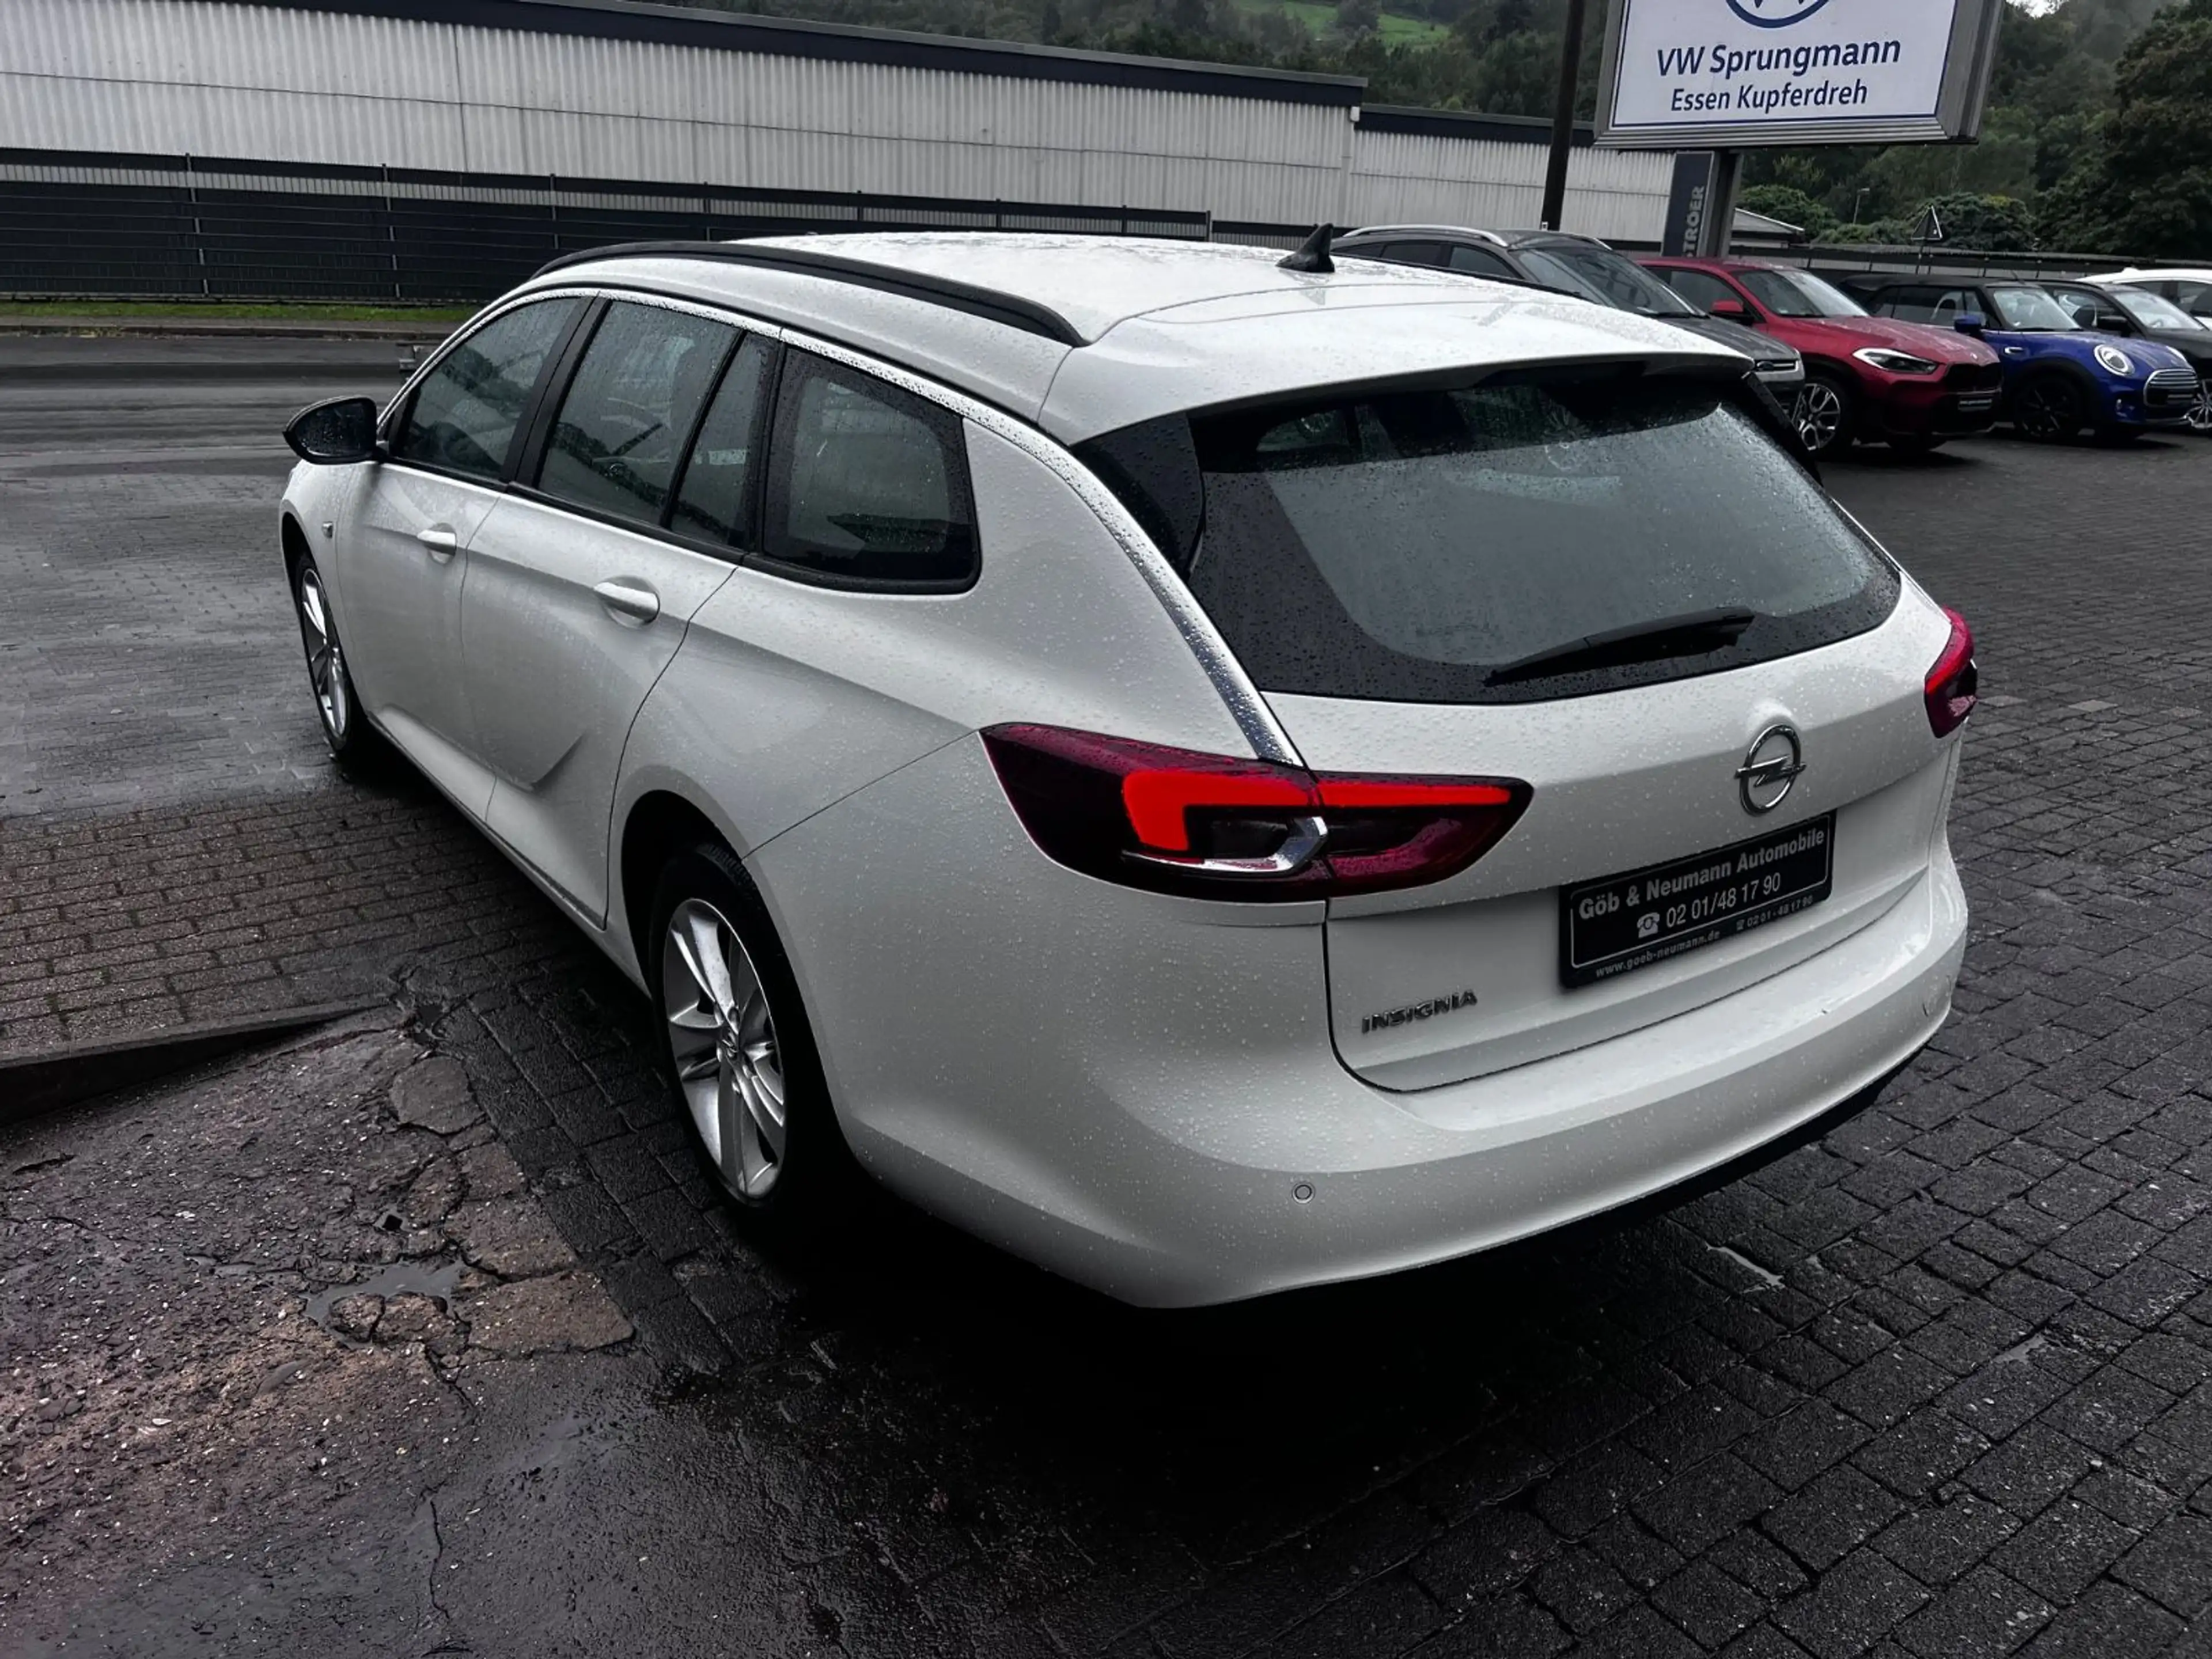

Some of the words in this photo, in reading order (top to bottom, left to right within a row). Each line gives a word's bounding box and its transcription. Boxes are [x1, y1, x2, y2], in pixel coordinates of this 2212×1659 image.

[1657, 47, 1705, 75] VW
[1710, 40, 1900, 79] Sprungmann
[1671, 89, 1730, 112] Essen
[1736, 79, 1868, 114] Kupferdreh
[1579, 894, 1619, 919] Göb
[1626, 885, 1641, 907] &
[1646, 860, 1732, 902] Neumann
[1737, 828, 1825, 873] Automobile
[1666, 904, 1687, 928] 02
[1691, 889, 1737, 918] 01/48
[1741, 880, 1759, 903] 17
[1763, 872, 1781, 895] 90
[1596, 930, 1720, 978] www.goeb-neumann.de
[1361, 988, 1478, 1035] INSIGNIA
